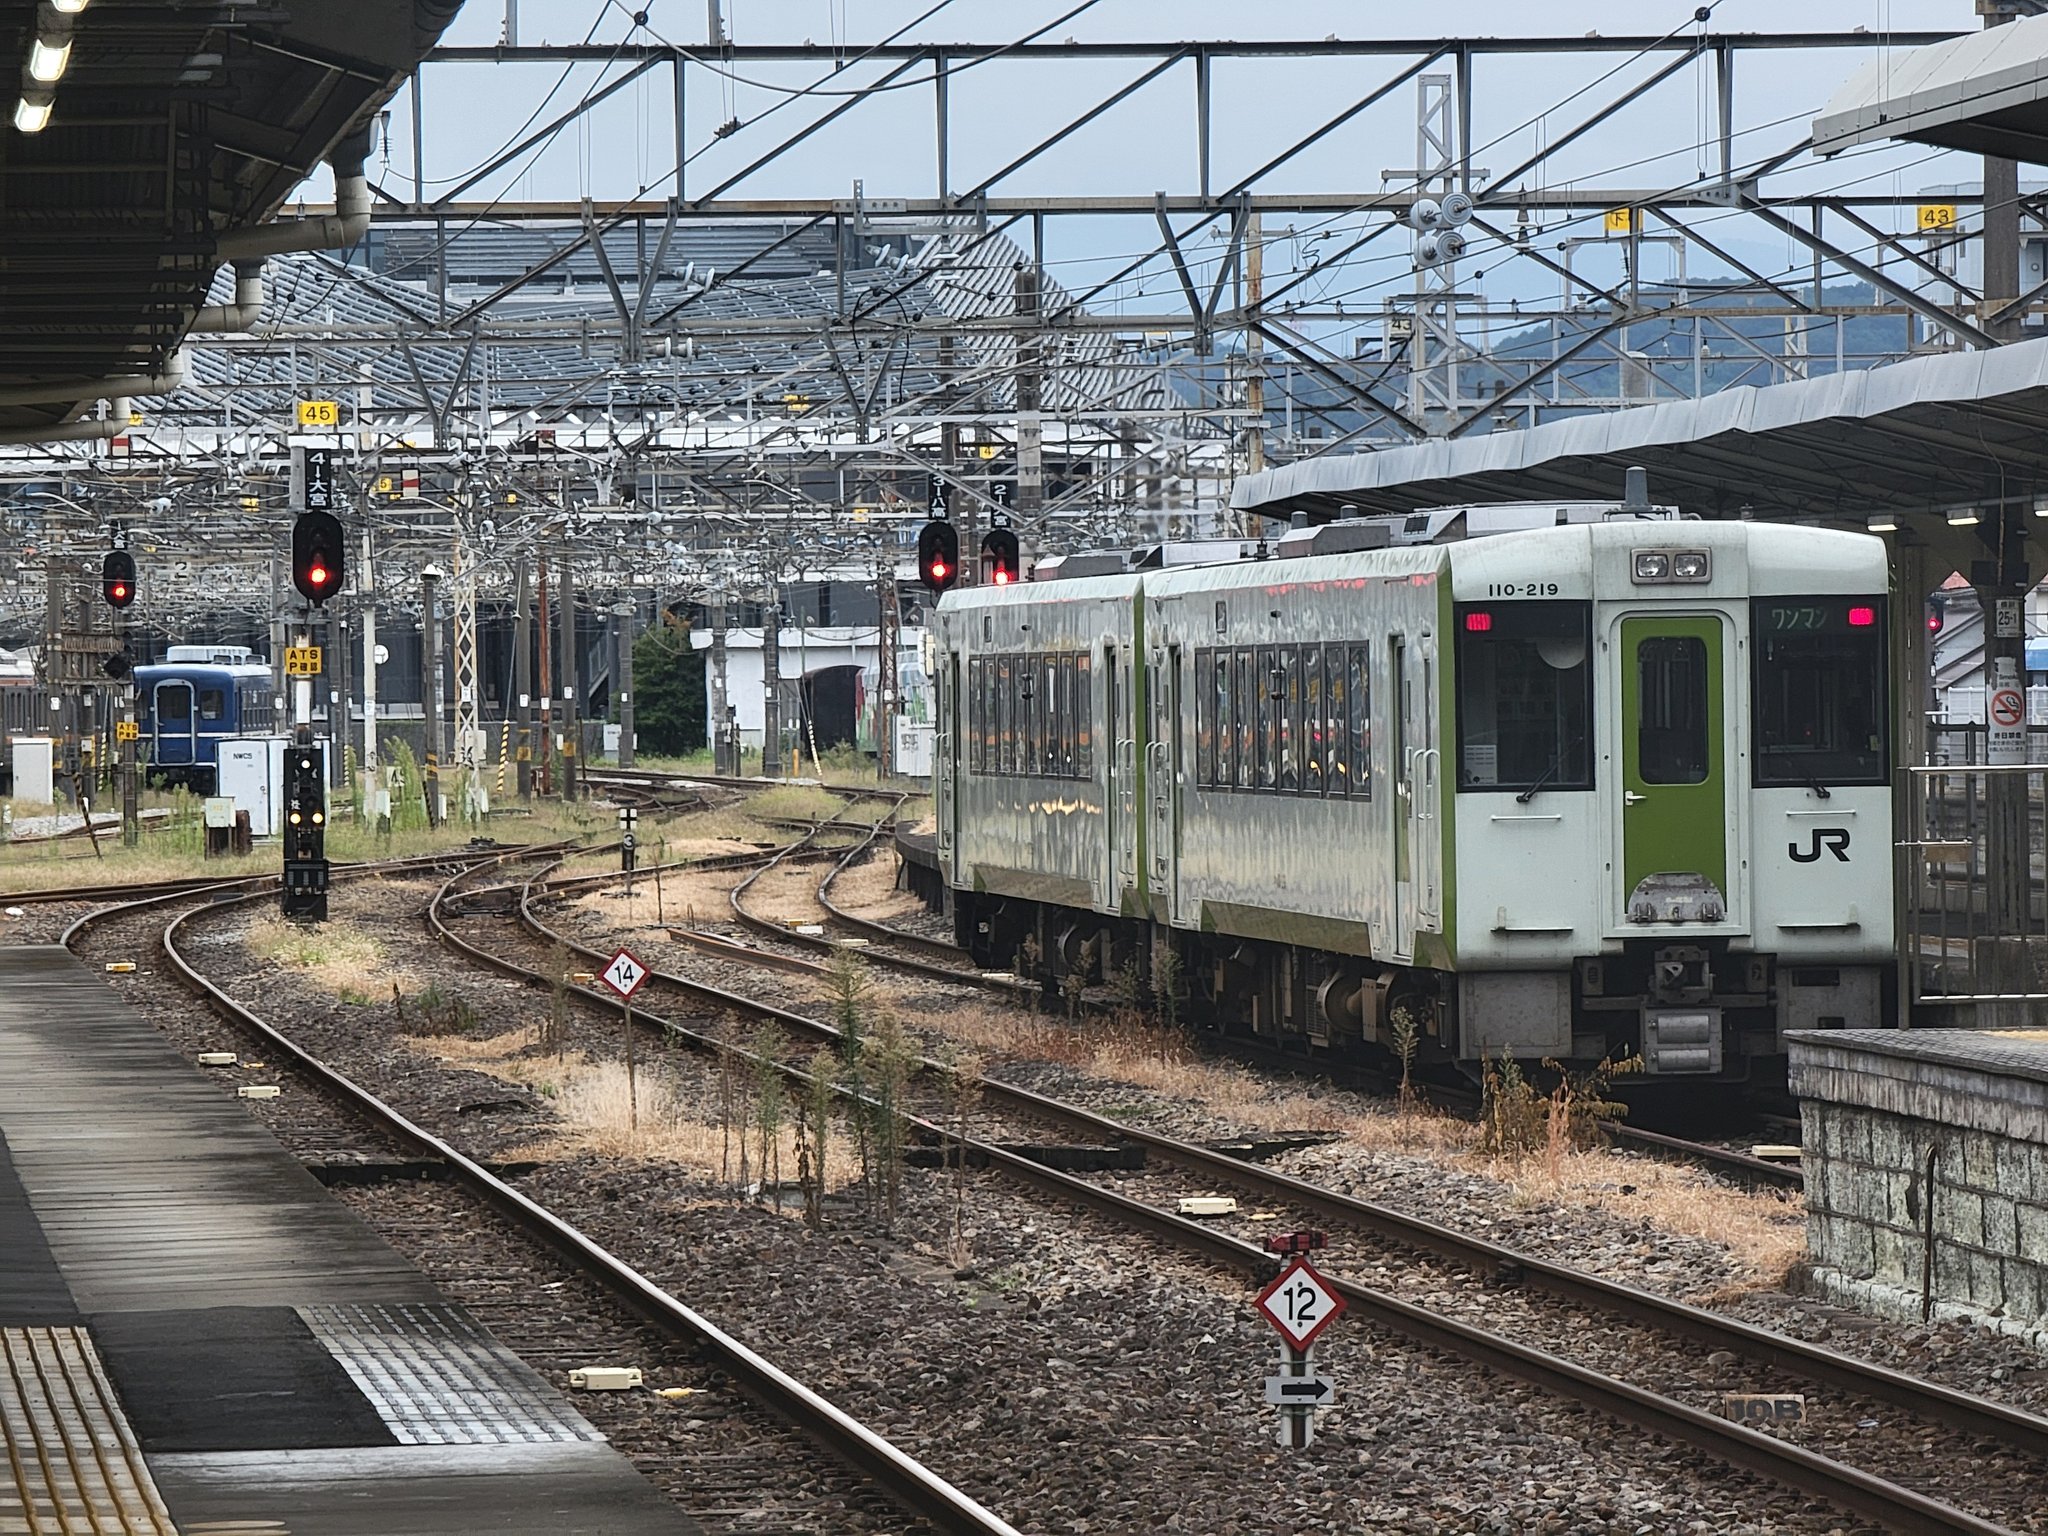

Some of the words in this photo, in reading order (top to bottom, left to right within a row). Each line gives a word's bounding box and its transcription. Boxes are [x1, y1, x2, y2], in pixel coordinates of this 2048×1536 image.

[1924, 208, 1949, 225] 43
[305, 405, 331, 421] 45
[309, 452, 326, 464] 4
[308, 480, 329, 506] 大宮
[994, 484, 1007, 495] 2
[1489, 583, 1558, 597] 110-219
[1772, 608, 1828, 629] ワンマン
[290, 650, 318, 660] ATS
[1788, 828, 1851, 863] JR
[614, 964, 635, 984] 14
[1283, 1287, 1317, 1321] 12
